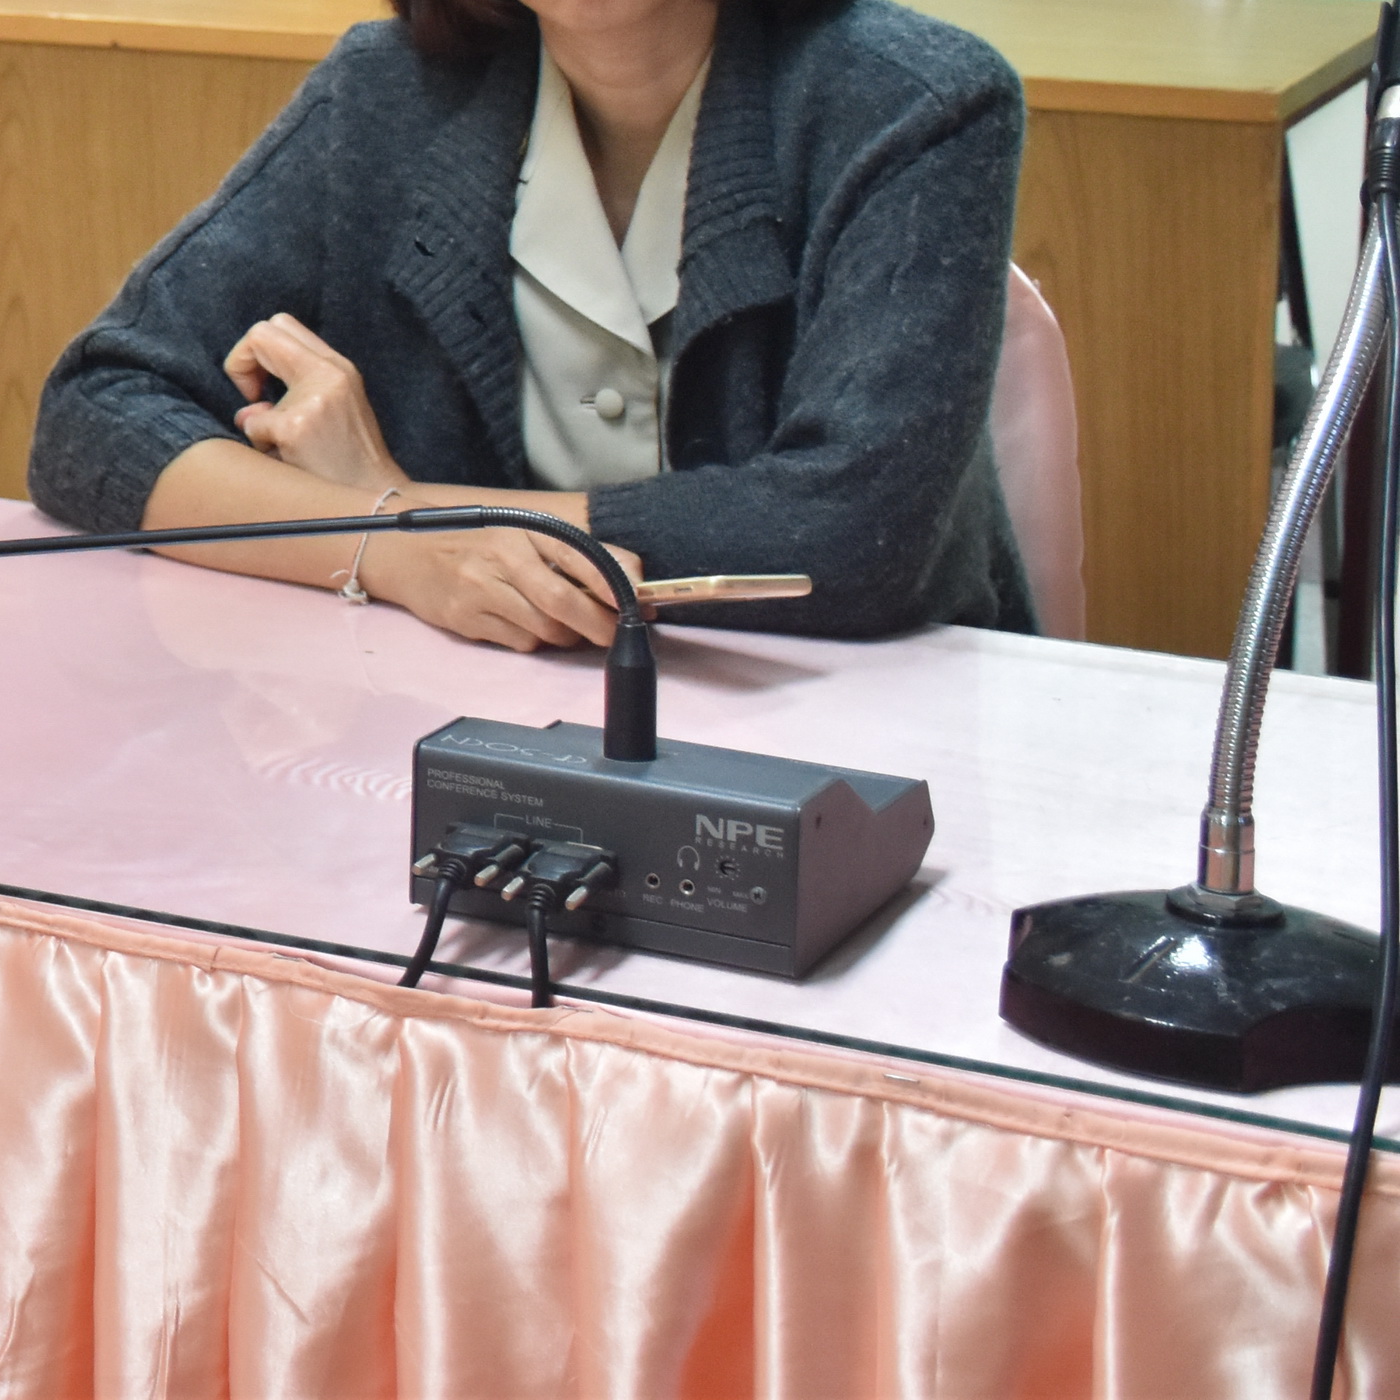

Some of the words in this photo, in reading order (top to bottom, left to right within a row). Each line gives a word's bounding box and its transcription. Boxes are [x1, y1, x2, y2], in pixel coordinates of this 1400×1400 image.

[427, 768, 505, 789] PROFESSIONAL
[426, 779, 499, 800] CONFERENCE
[501, 791, 543, 807] SYSTEM
[525, 815, 552, 828] LINE
[695, 813, 785, 851] NPE
[695, 836, 784, 859] RESEARCH
[642, 893, 663, 905] REC
[670, 899, 704, 913] PHONE
[706, 898, 748, 913] VOLUME
